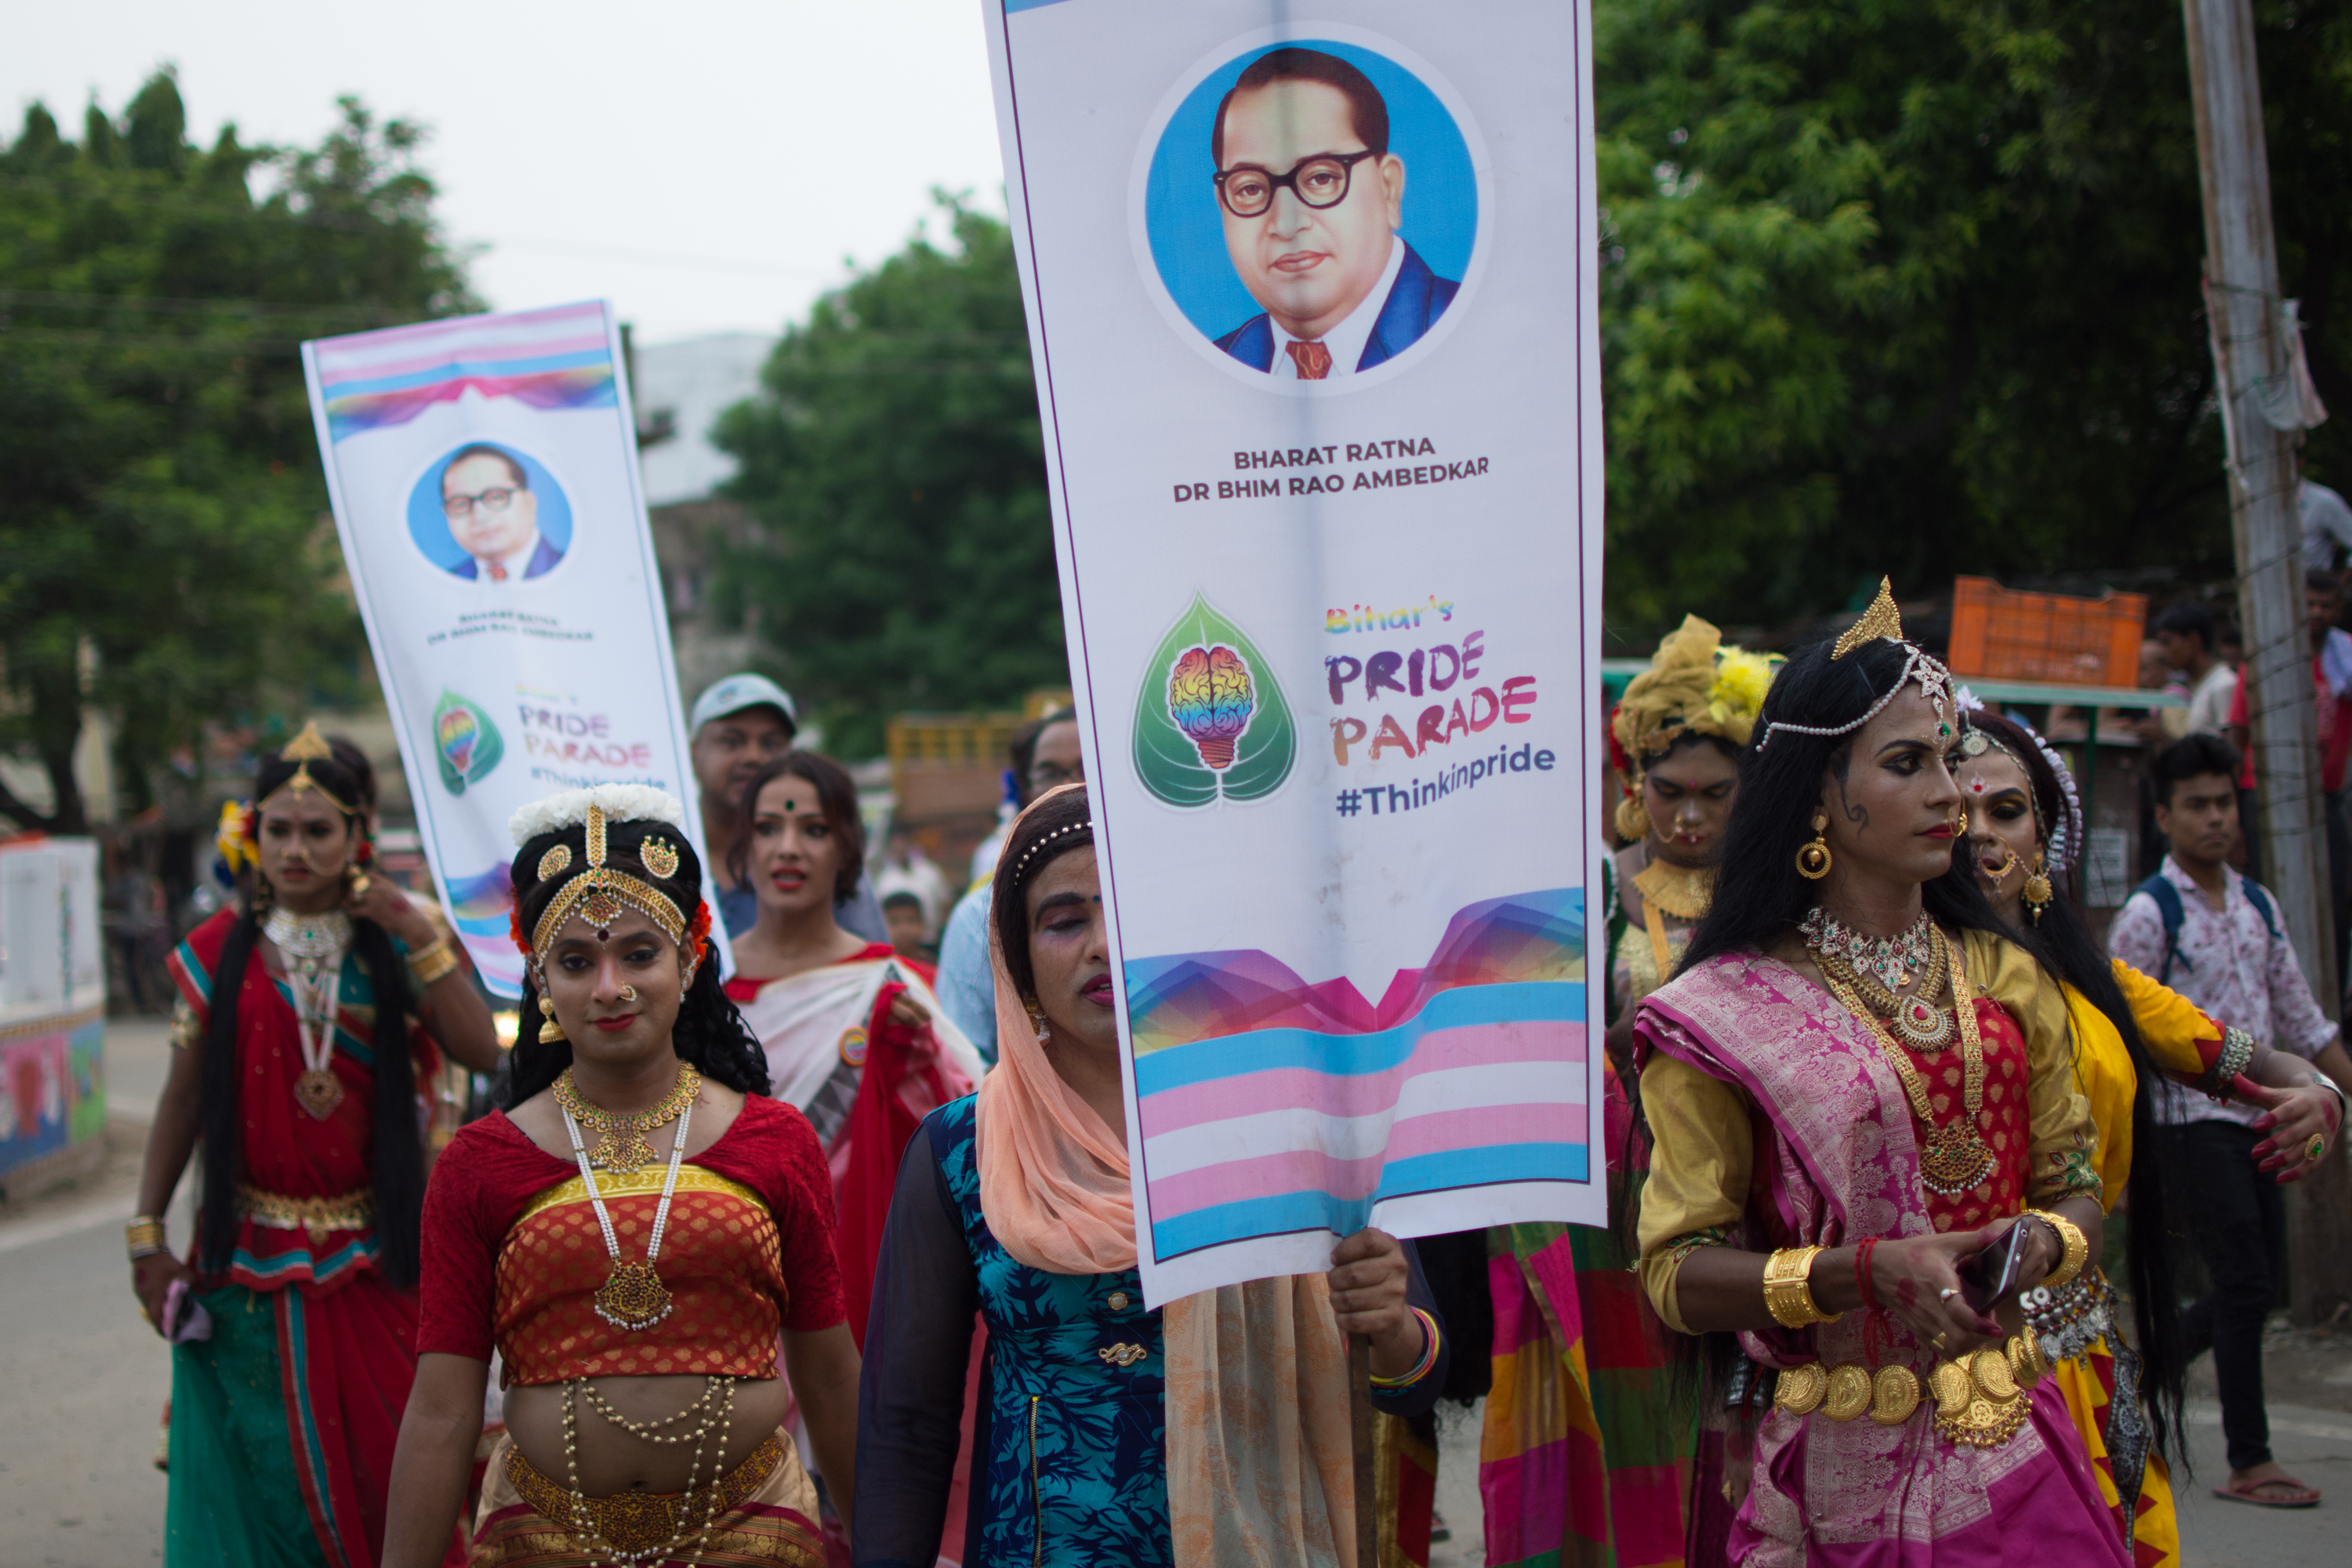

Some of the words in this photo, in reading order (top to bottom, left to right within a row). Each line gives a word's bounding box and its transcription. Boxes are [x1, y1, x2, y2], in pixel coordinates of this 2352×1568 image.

[1233, 445, 1338, 470] BHARAT
[1345, 437, 1436, 463] RATNA
[1173, 482, 1211, 503] DR
[1218, 477, 1281, 499] BHIM
[1288, 473, 1345, 496] RAO
[1352, 456, 1490, 492] AMBEDKAR
[1323, 594, 1454, 635] Bihar's
[1324, 629, 1485, 706] PRIDE
[517, 704, 610, 738] PRIDE
[1329, 676, 1538, 768] PARADE
[523, 732, 651, 768] PARADE
[1335, 742, 1557, 818] #Thinkinpride
